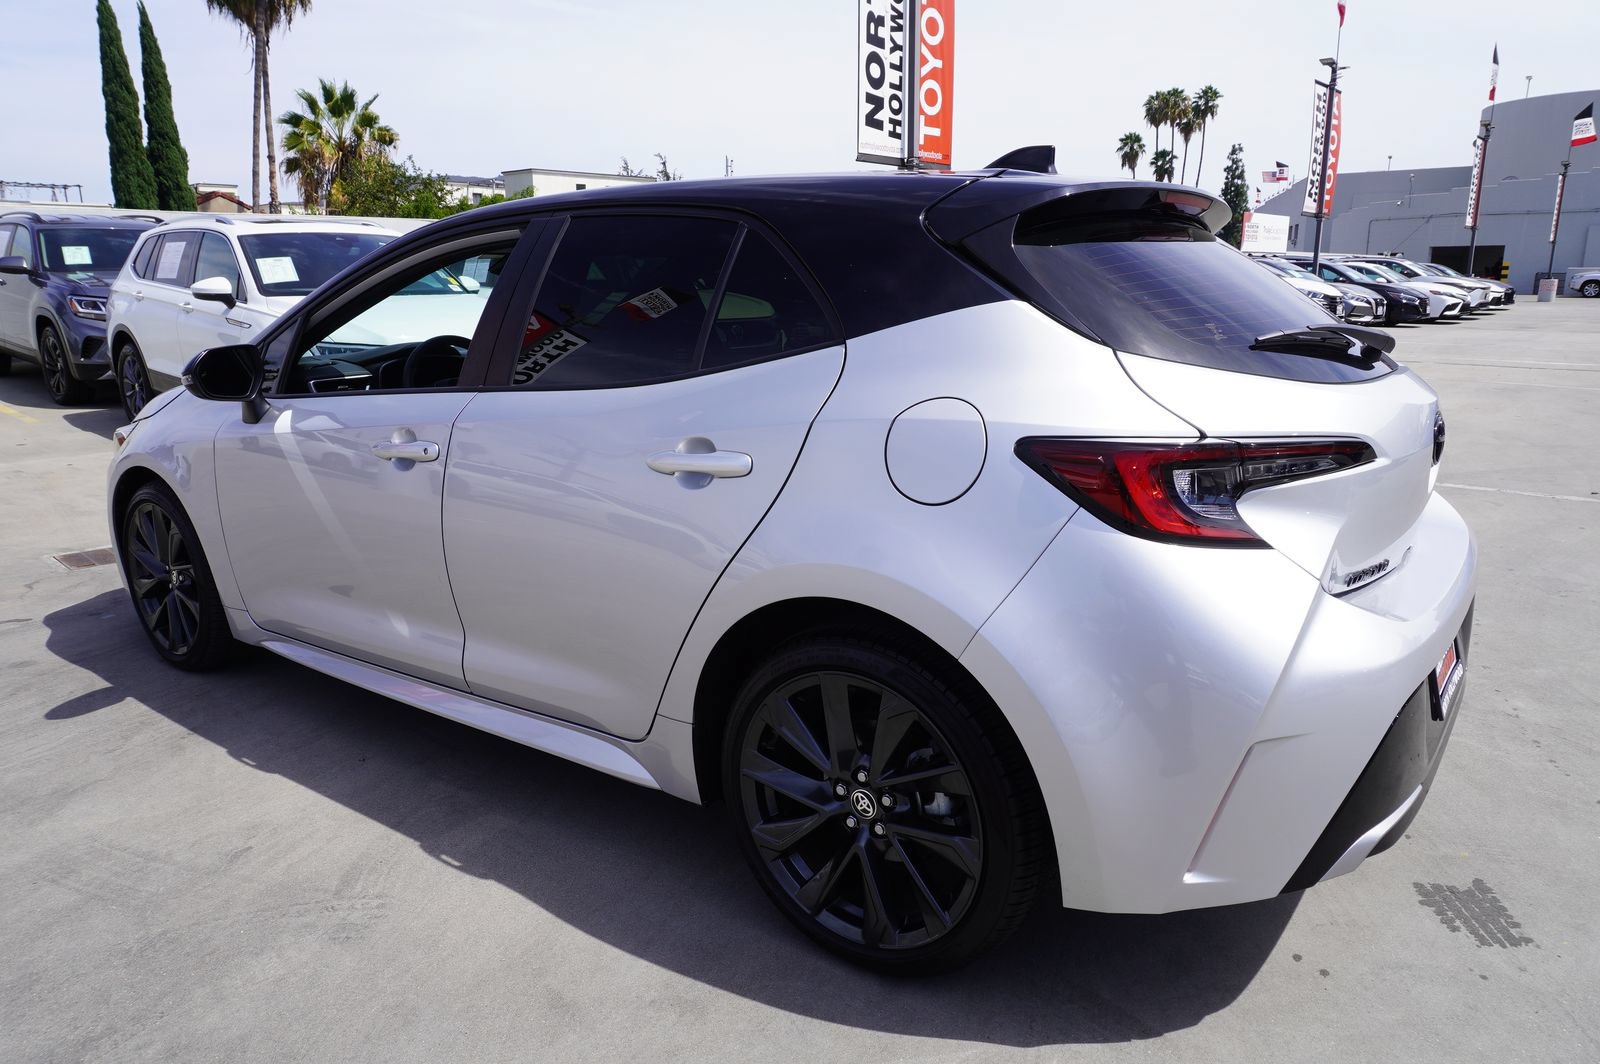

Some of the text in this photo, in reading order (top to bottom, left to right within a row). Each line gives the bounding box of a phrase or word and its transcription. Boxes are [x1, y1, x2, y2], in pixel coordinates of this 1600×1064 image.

[865, 0, 886, 131] NOR
[888, 0, 903, 140] HOLLYW
[919, 0, 945, 145] TOYO
[1308, 93, 1322, 199] NORTH
